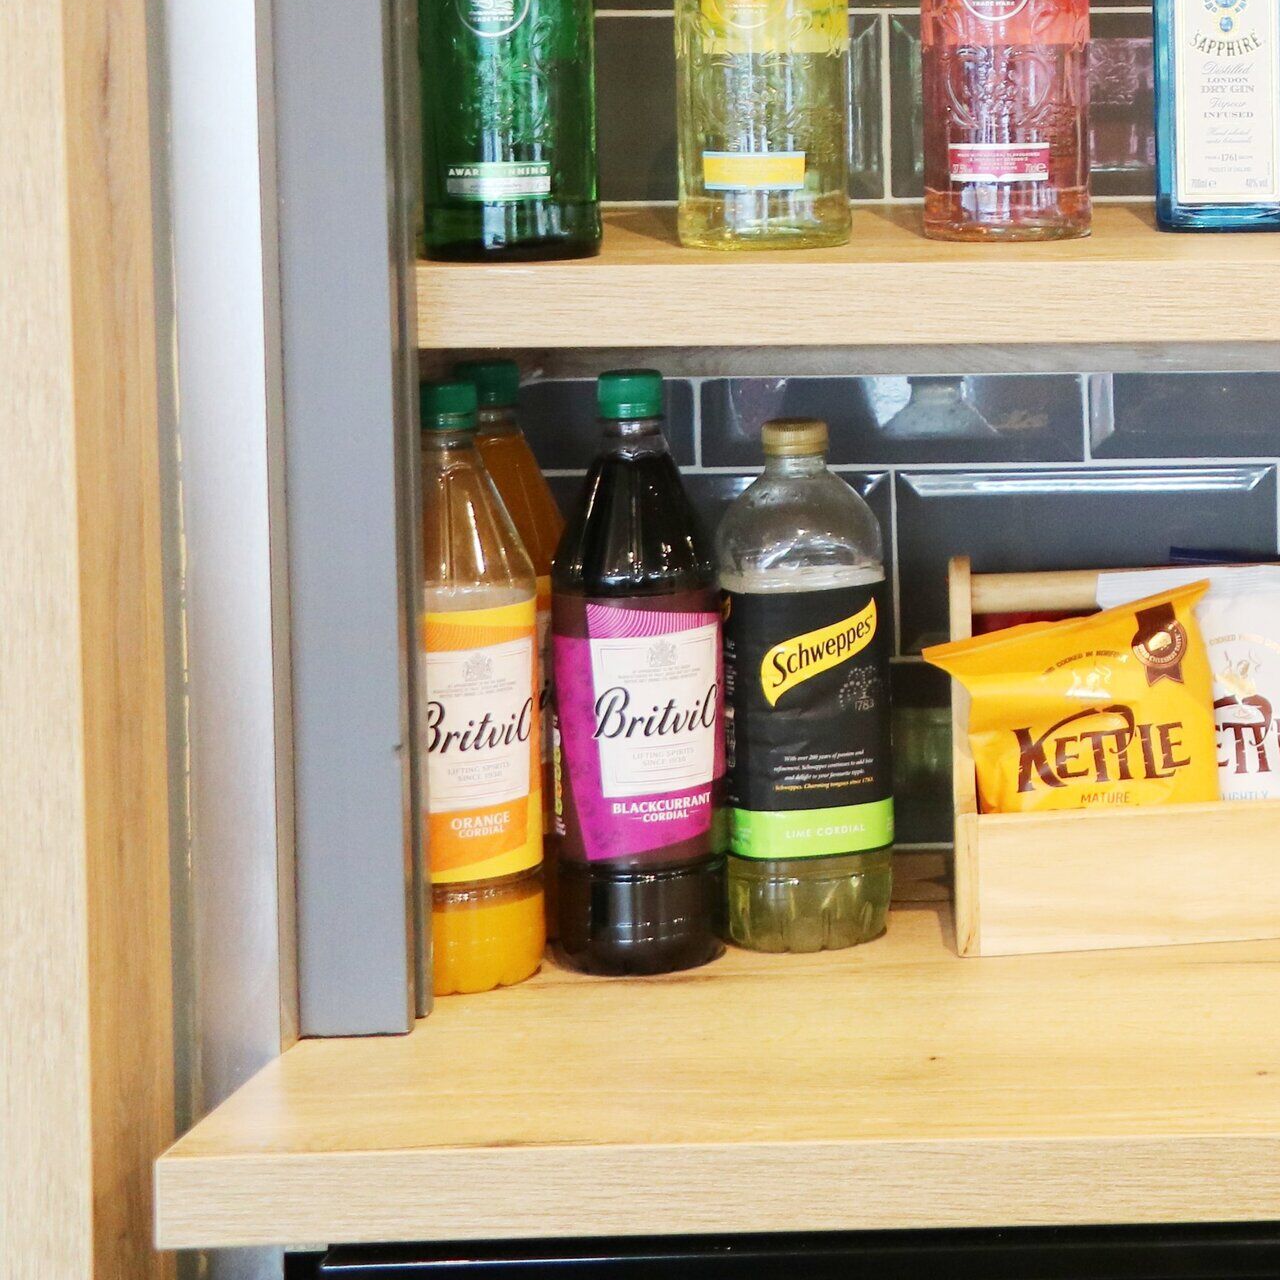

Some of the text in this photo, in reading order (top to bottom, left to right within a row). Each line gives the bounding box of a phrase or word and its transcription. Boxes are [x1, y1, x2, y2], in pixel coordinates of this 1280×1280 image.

[1190, 32, 1263, 58] SAPPHIRE
[1201, 60, 1254, 76] Distilled
[1200, 85, 1256, 94] DRY GIN
[1203, 111, 1255, 119] INFUSED
[771, 614, 874, 688] Schweppes
[592, 682, 719, 740] Britvic
[854, 699, 875, 711] 1783
[1012, 704, 1192, 794] KETTLE
[612, 790, 712, 816] BLACKCURRANT
[1080, 791, 1131, 805] MATURE
[450, 811, 511, 831] ORANGE
[642, 809, 690, 823] CORDIAL
[457, 825, 505, 839] CORDIAL
[785, 823, 866, 840] LIME CORDIAL
